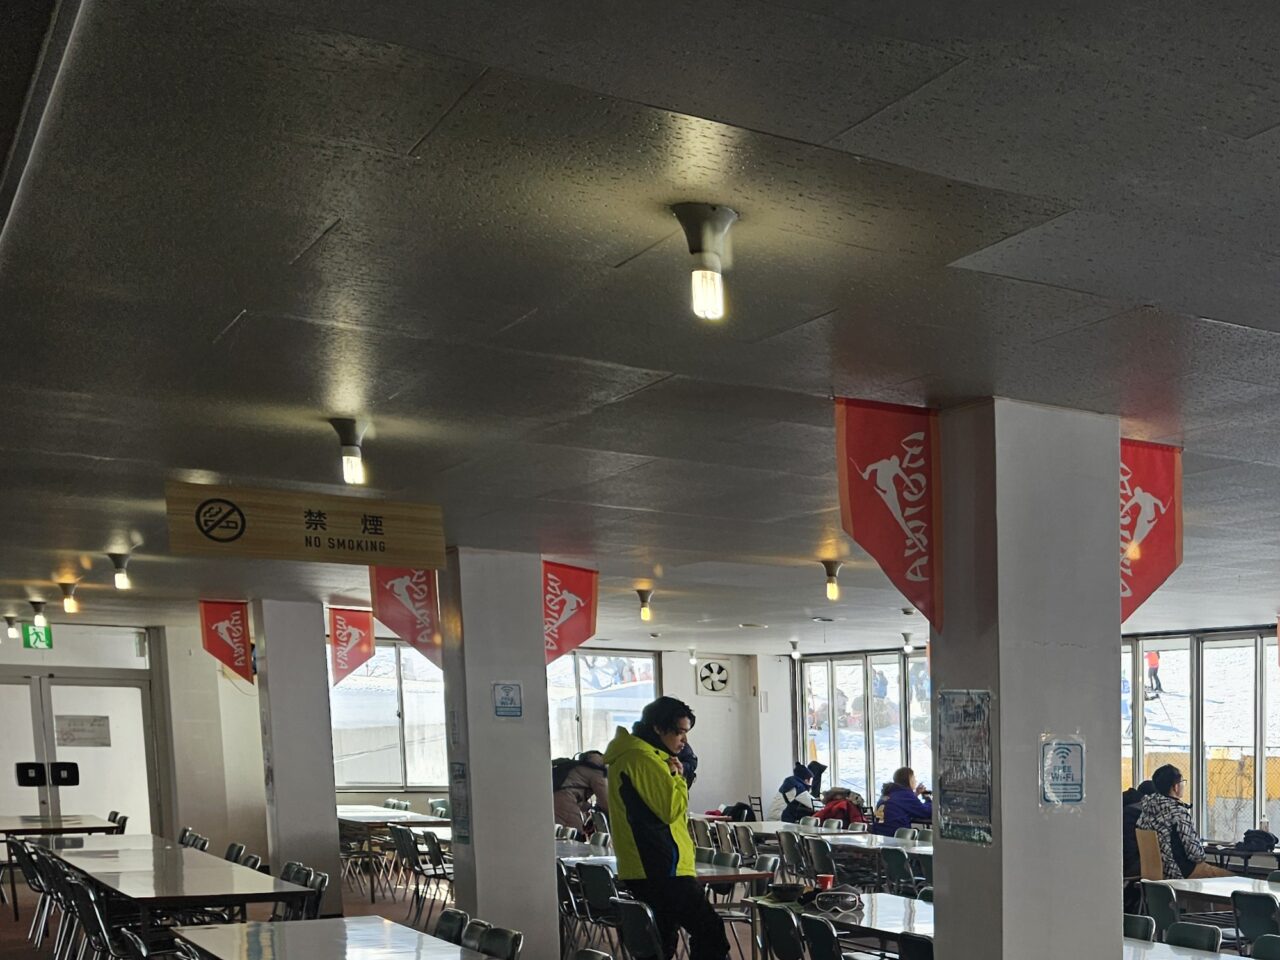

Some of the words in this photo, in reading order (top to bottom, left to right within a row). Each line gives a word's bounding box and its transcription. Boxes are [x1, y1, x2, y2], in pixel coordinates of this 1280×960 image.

[304, 508, 384, 536] 禁煙
[305, 535, 321, 548] NO
[327, 537, 386, 553] SMOKING
